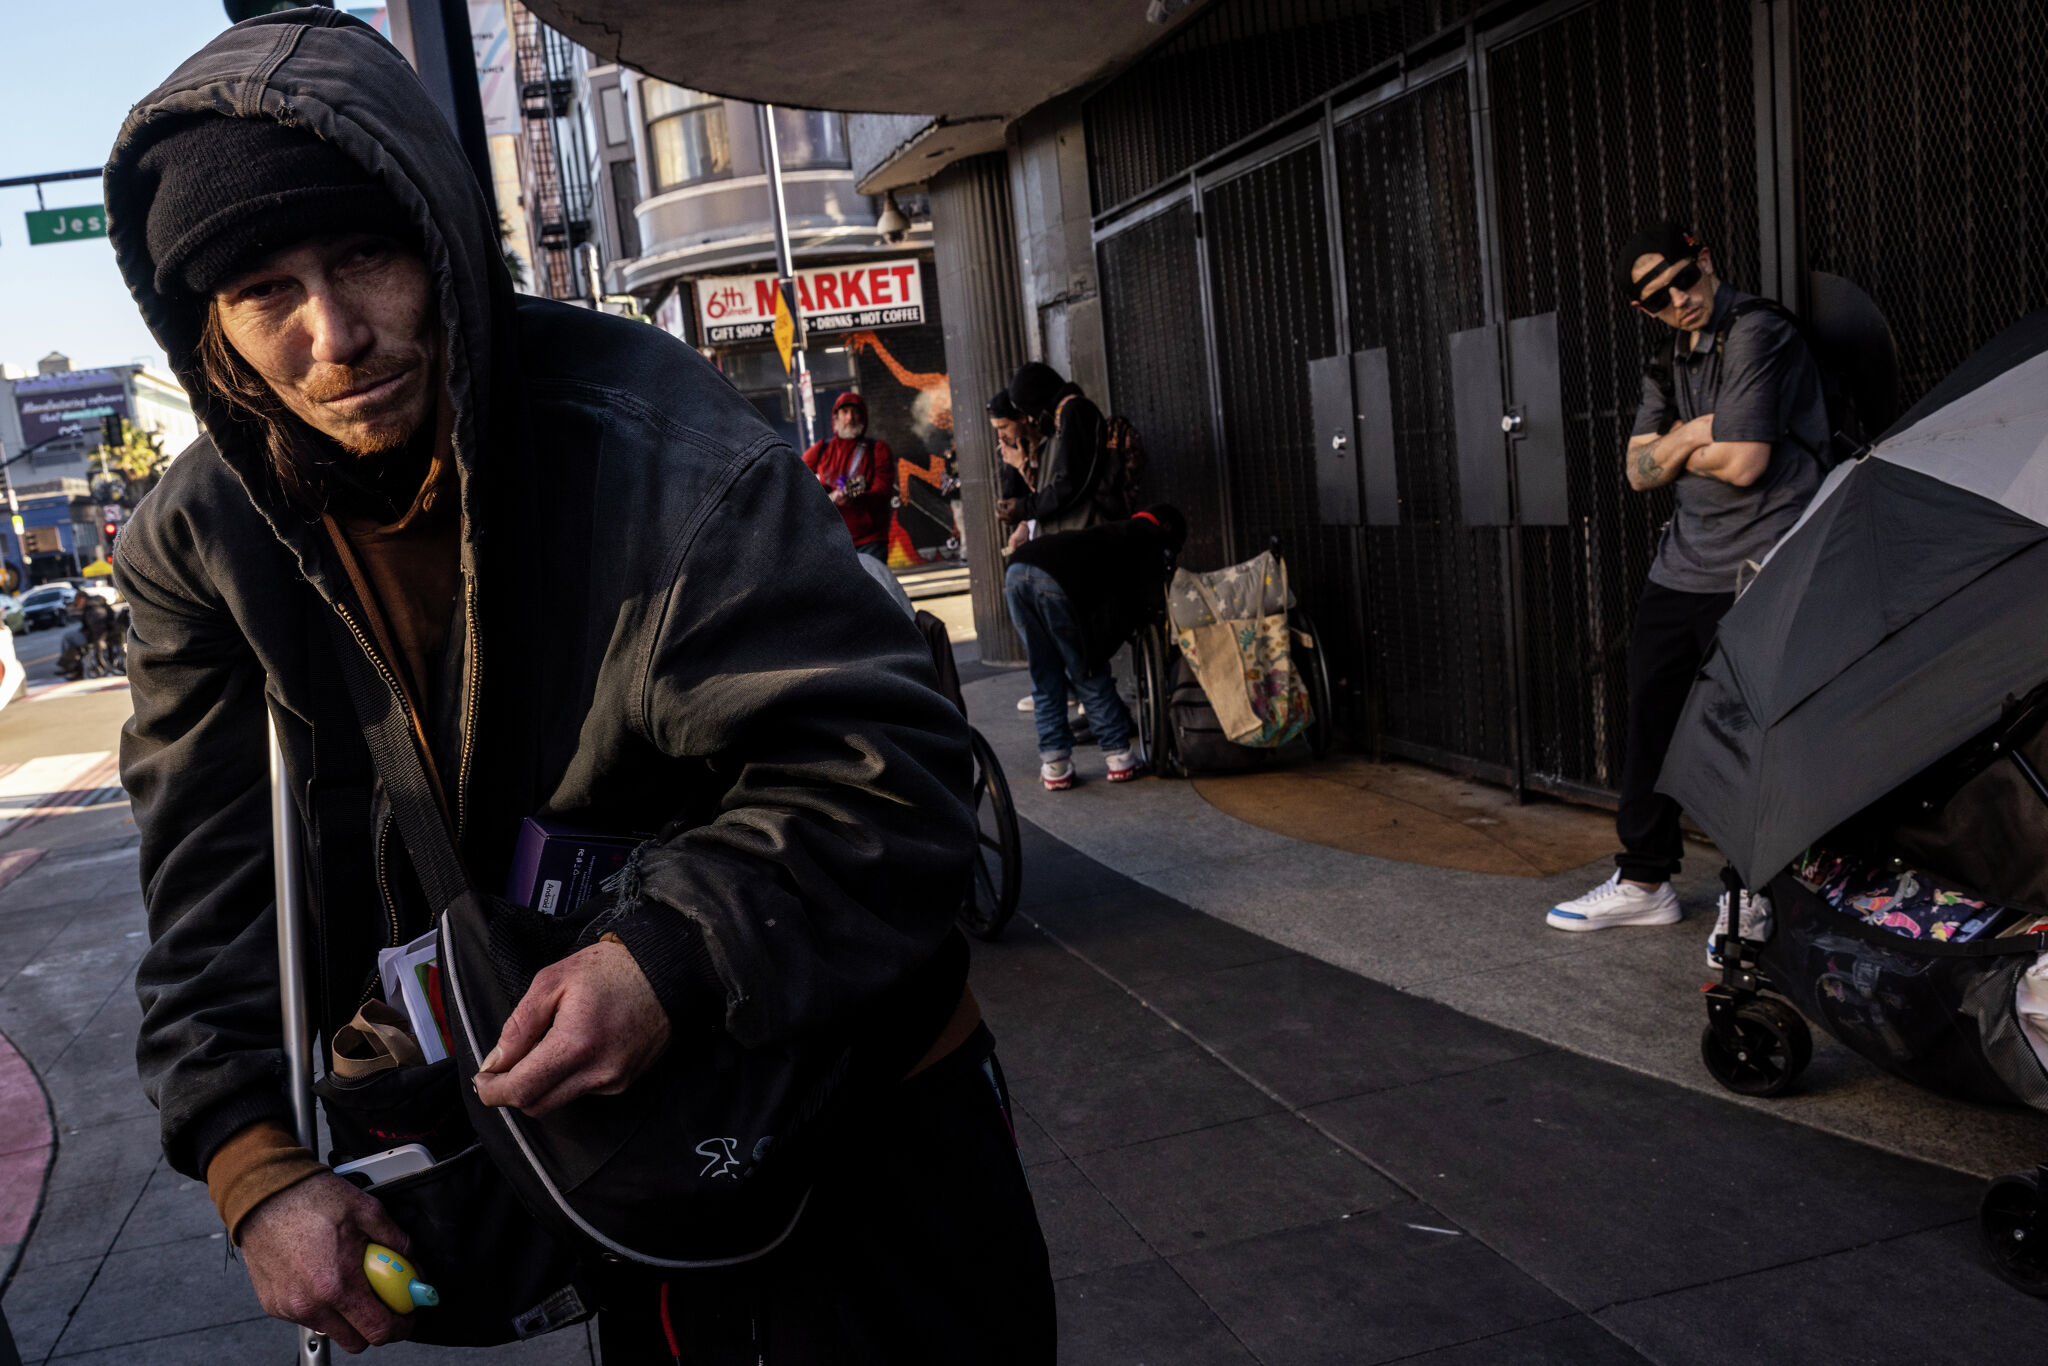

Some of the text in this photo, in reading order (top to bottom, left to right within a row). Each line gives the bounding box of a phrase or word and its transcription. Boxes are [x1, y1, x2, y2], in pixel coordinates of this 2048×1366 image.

[707, 286, 744, 319] 6th
[755, 265, 914, 317] MARKET
[711, 327, 735, 341] GIFT
[736, 323, 764, 338] SHOP
[816, 314, 854, 330] DRINKS
[860, 310, 881, 325] HOT
[882, 307, 919, 323] COFFEE
[543, 883, 554, 909] Android
